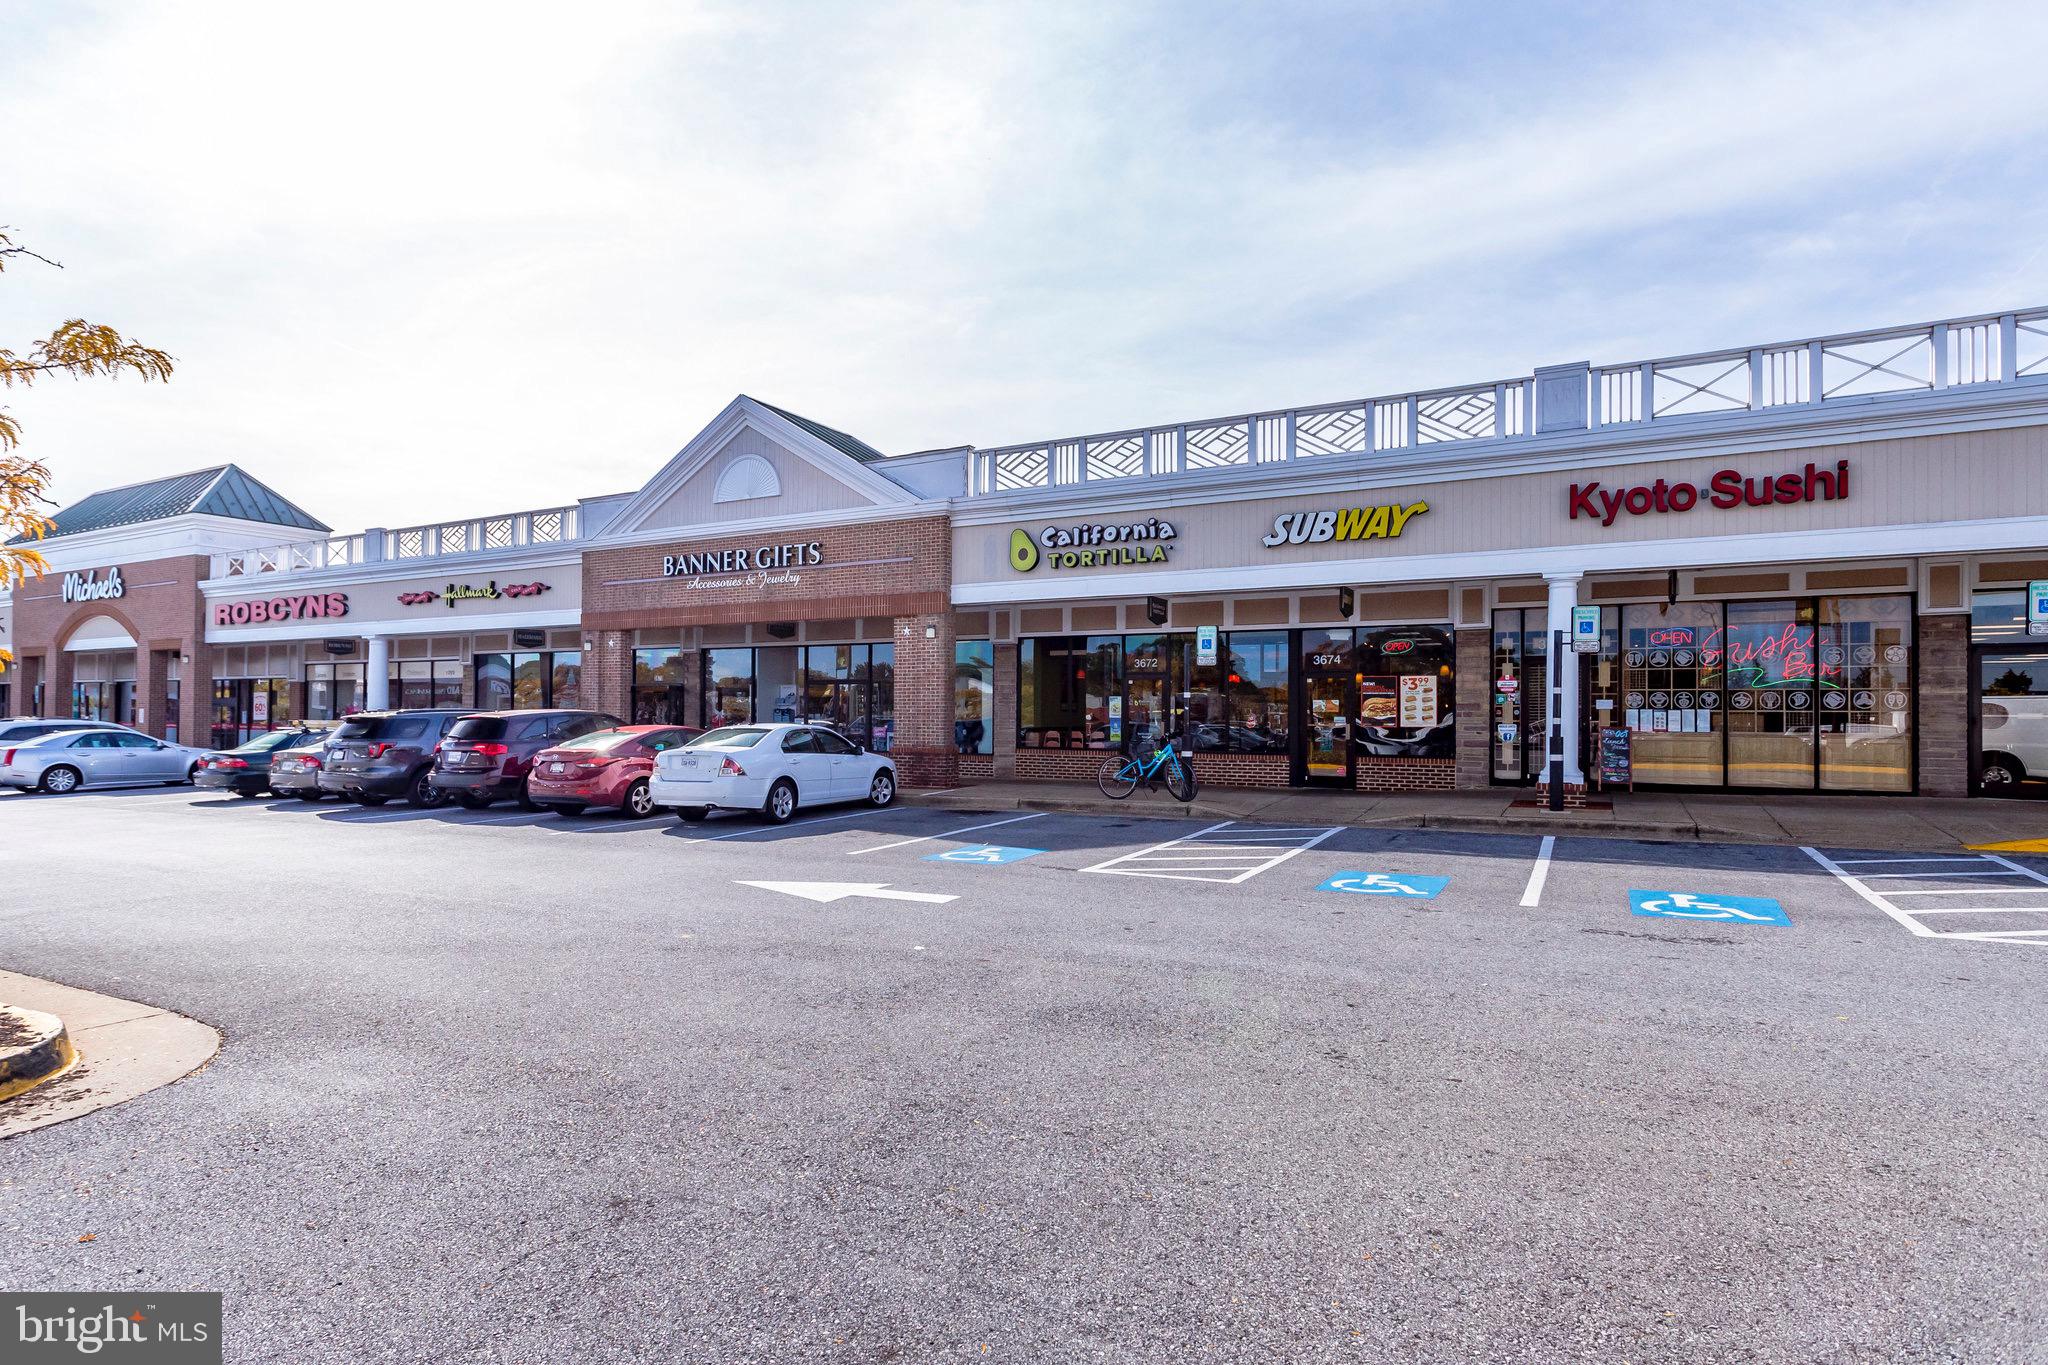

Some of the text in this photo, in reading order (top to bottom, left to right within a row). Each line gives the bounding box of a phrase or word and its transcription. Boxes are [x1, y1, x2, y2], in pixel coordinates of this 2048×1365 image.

[1570, 460, 1849, 527] Kyoto Sushi
[1040, 518, 1177, 549] California
[1261, 499, 1430, 548] SUBWAY
[662, 541, 824, 577] BANNER GIFTS
[1048, 545, 1169, 569] TORTILLA
[62, 566, 126, 603] Michaels
[441, 580, 502, 609] Hallmark
[686, 570, 802, 590] Accessories & Jewelry
[214, 592, 349, 626] ROBCYNS
[1385, 641, 1411, 651] OPEN
[1651, 631, 1692, 644] OPEN
[1134, 658, 1158, 668] 3672
[1313, 654, 1341, 665] 3674
